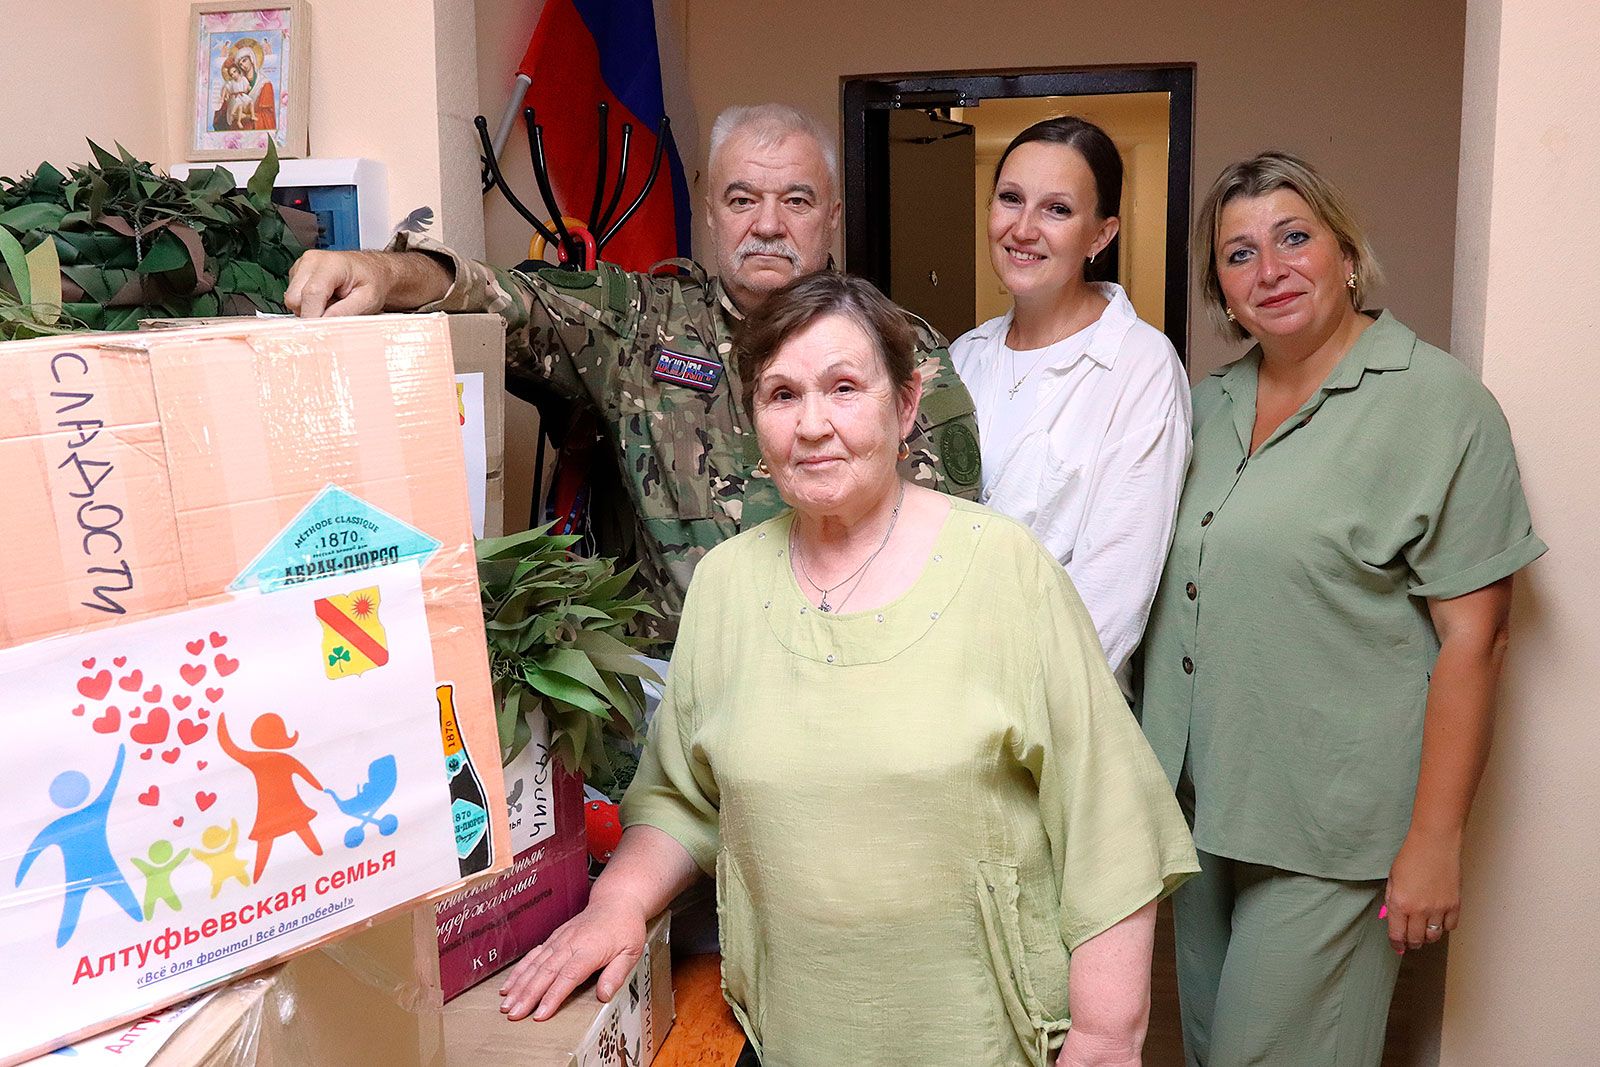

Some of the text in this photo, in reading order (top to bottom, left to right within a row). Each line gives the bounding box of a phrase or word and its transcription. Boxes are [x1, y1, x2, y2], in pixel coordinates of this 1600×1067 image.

[50, 352, 134, 615] СЛАДОСТИ
[335, 516, 380, 534] CLASSIQUE
[320, 530, 359, 548] 1870
[445, 720, 456, 748] 1870
[529, 743, 549, 838] ЧИПСЫ
[72, 850, 397, 985] Алтуфьевская семья
[137, 897, 354, 986] «Всё для фронта! Всё для победы!»
